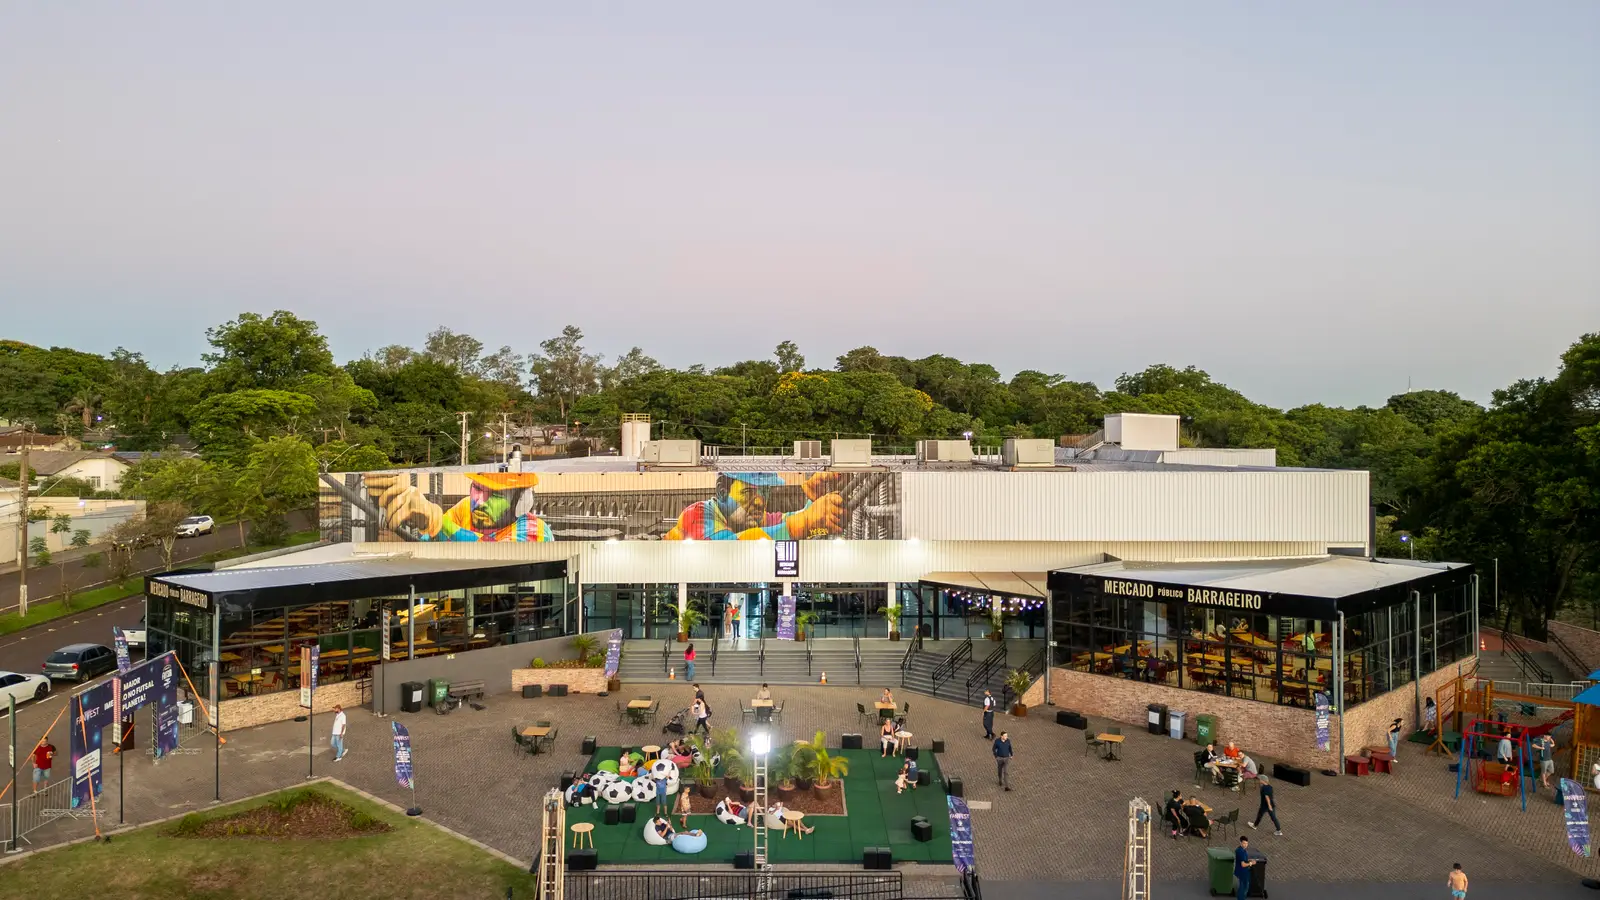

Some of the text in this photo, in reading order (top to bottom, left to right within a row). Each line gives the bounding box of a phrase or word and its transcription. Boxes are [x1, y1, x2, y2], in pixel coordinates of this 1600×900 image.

[1104, 579, 1262, 609] MERCADO PÚBLICO BARRAGEIRO
[123, 677, 141, 691] MAIOR
[128, 688, 136, 699] NO
[135, 680, 155, 695] FUTSAL
[122, 693, 147, 712] PLANETA!
